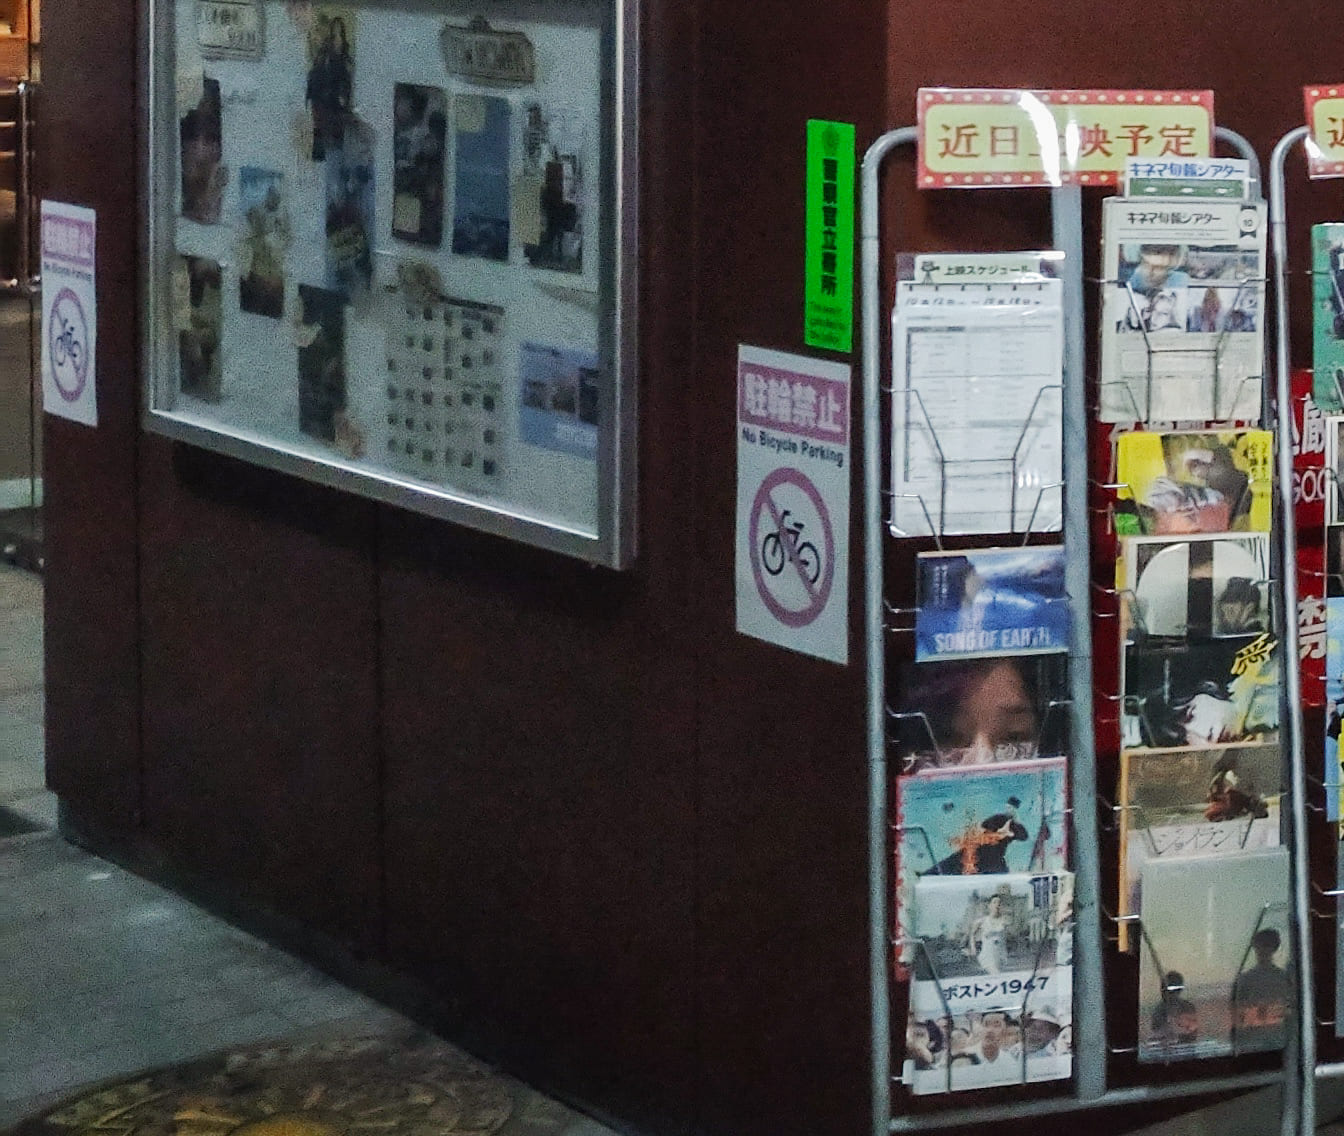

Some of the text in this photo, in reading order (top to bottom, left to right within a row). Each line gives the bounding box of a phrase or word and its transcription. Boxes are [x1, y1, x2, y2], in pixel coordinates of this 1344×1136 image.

[937, 123, 1198, 159] 近日映予定
[1129, 162, 1247, 178] キネマ旬報シアター
[1127, 211, 1222, 225] キネマ旬報シアター
[743, 372, 843, 433] 駐輪禁止
[742, 428, 845, 469] No Bicycle Parking
[934, 631, 975, 653] SONG
[977, 629, 999, 650] OF
